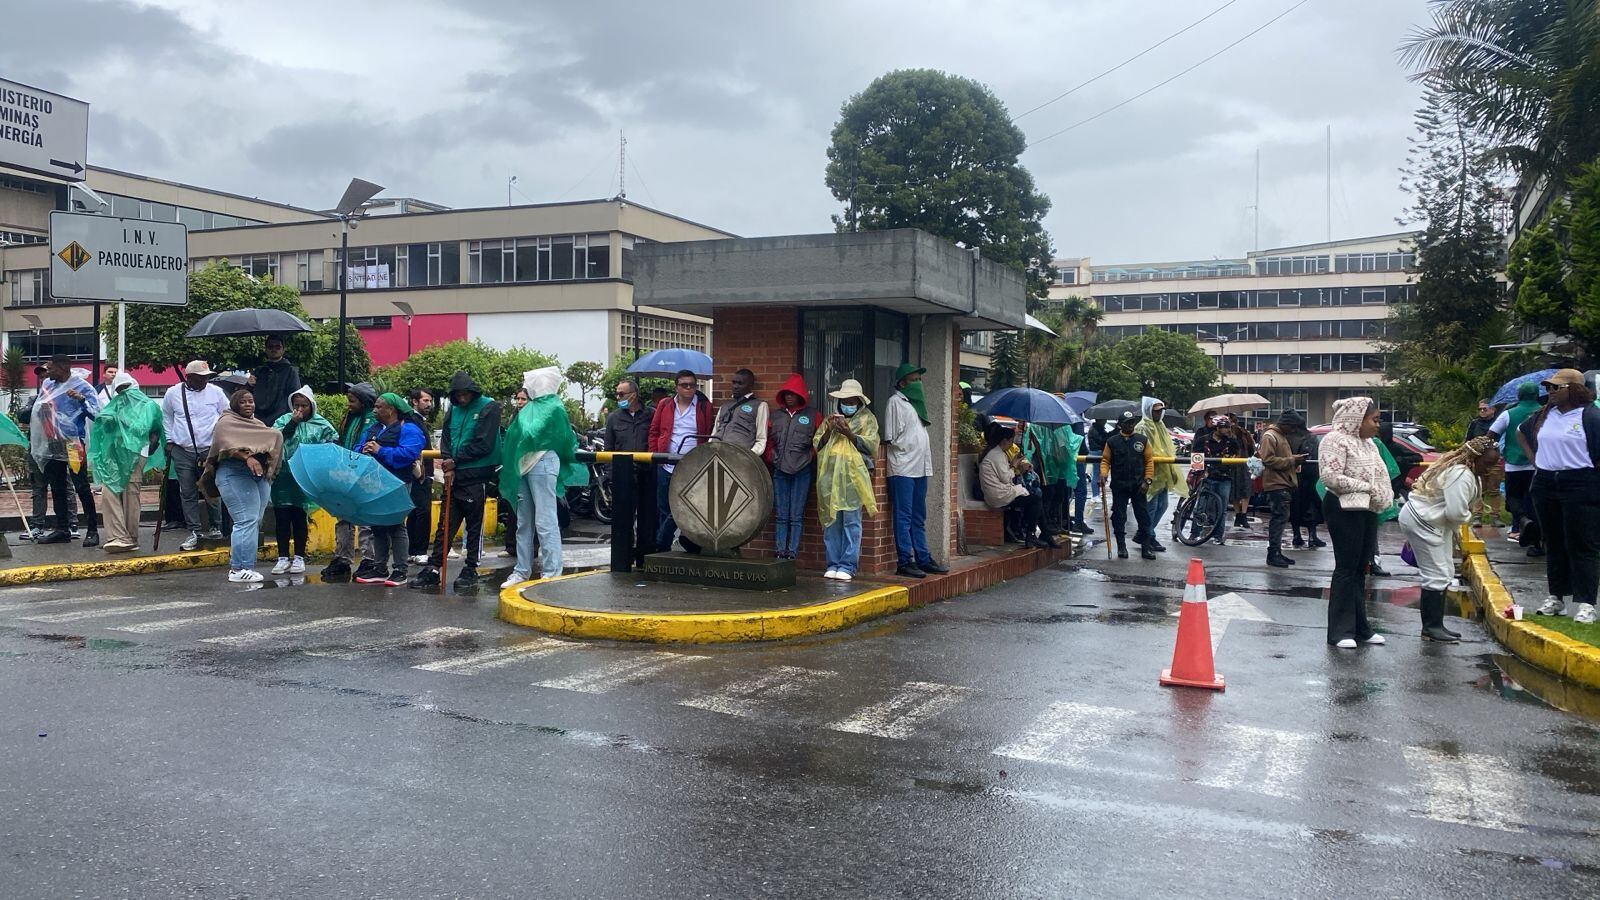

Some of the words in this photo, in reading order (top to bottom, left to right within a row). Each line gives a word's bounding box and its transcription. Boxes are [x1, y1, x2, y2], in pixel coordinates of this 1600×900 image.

[0, 88, 52, 114] ISTERIO
[98, 251, 183, 271] PARQUEADERO
[645, 564, 685, 575] INSTITUTO
[733, 571, 744, 580] DE
[747, 571, 767, 582] VIAS
